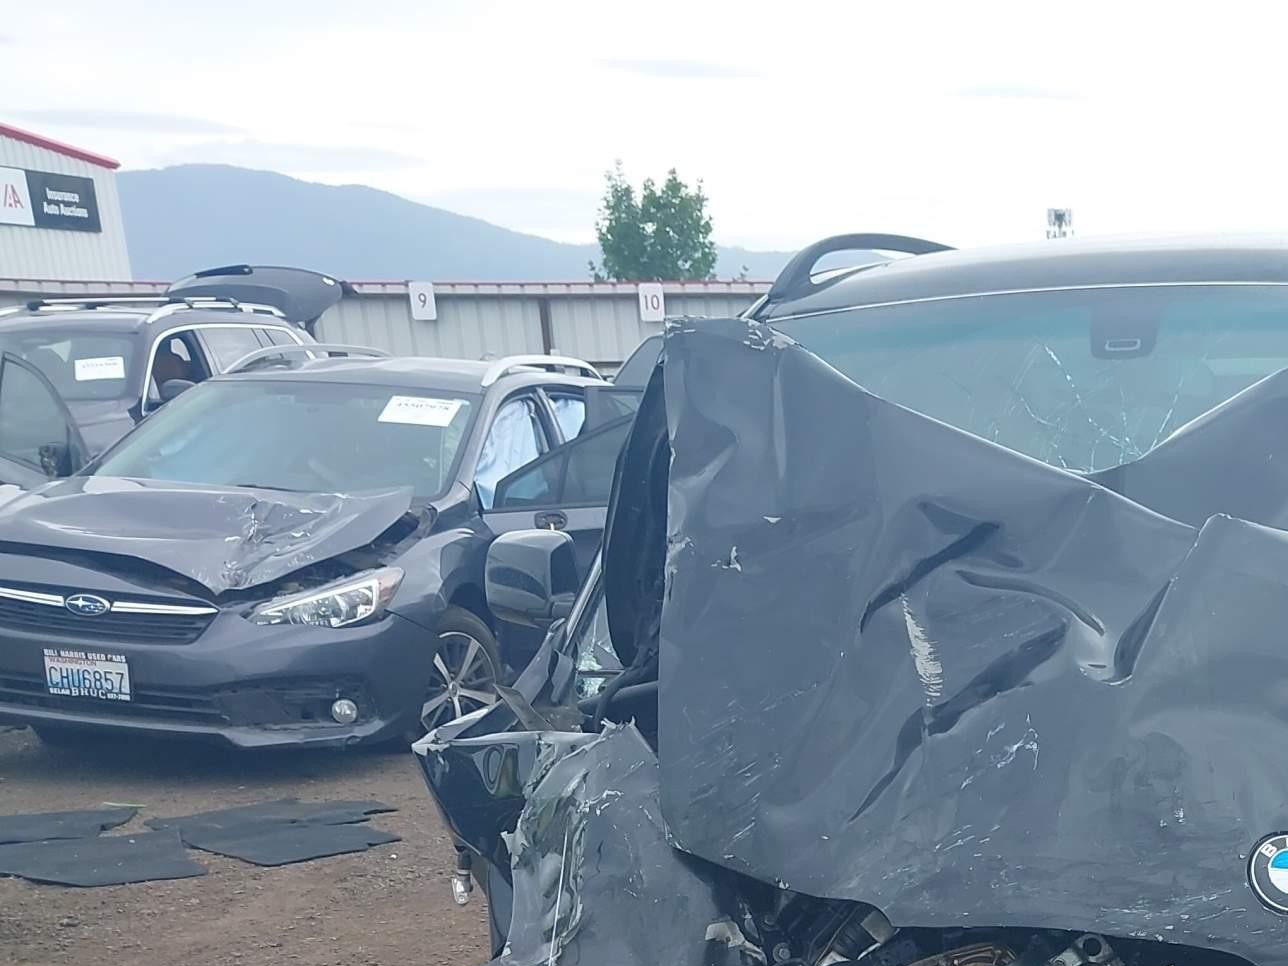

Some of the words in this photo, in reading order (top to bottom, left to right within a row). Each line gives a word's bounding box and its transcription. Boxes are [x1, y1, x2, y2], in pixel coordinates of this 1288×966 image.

[418, 293, 427, 309] 9
[644, 294, 660, 311] 10
[87, 652, 106, 661] USED
[107, 654, 127, 663] CARS
[48, 666, 125, 694] CHU6857
[71, 687, 106, 700] BHUC
